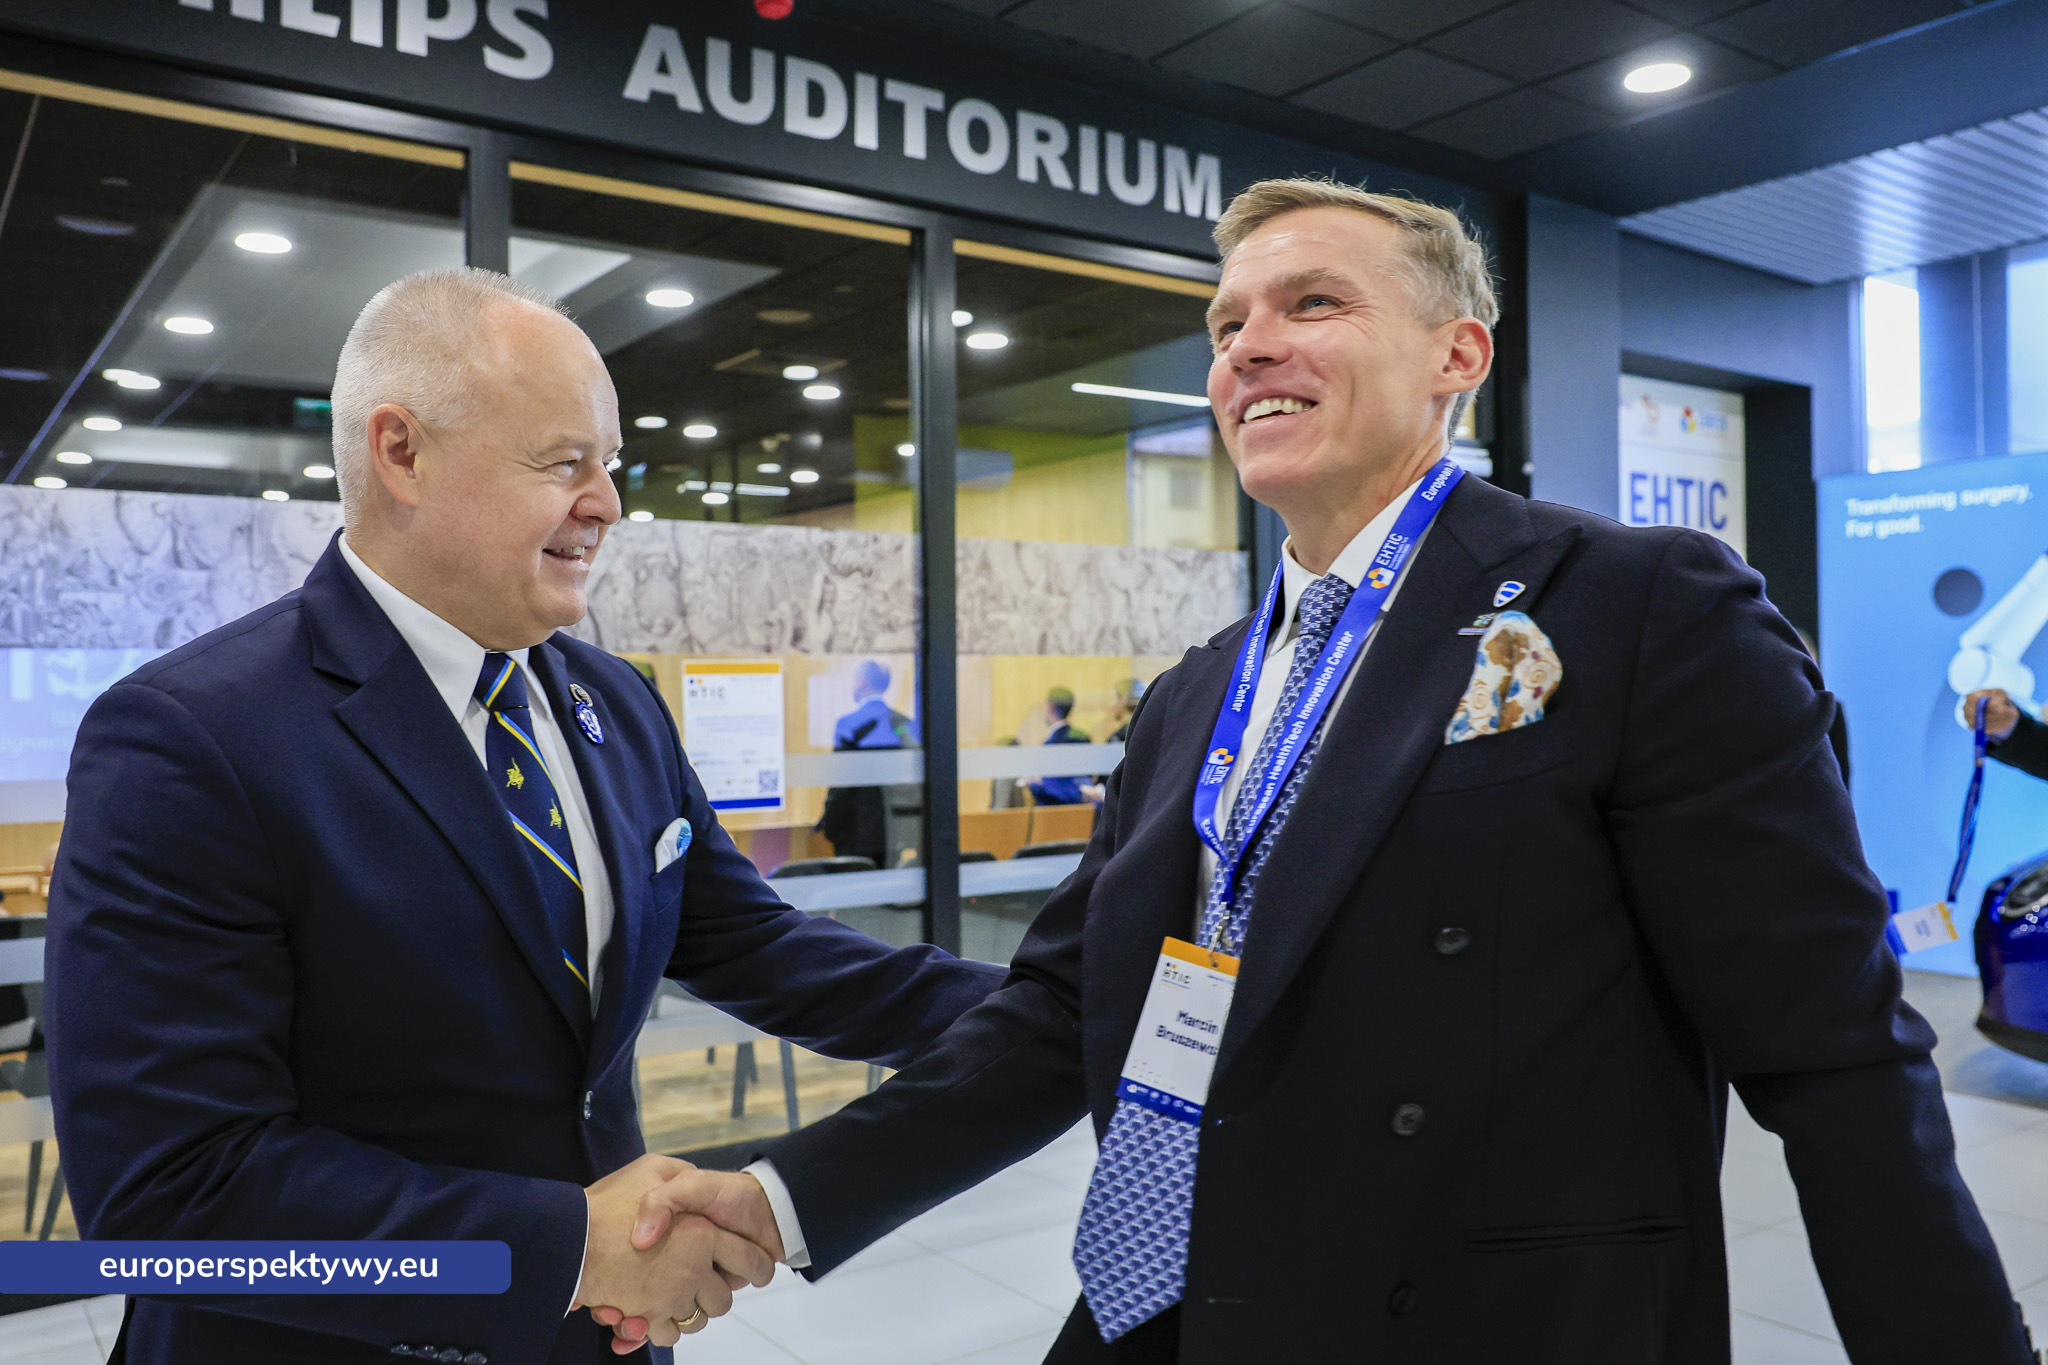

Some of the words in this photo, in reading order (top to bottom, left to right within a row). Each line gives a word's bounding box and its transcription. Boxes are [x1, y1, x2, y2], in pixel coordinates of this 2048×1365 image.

[622, 23, 1222, 221] AUDITORIUM
[1421, 467, 1455, 501] European
[1630, 472, 1728, 530] EHTIC
[1375, 533, 1403, 566] EHTIC
[1241, 633, 1262, 683] Innovation
[1231, 683, 1251, 713] Center
[1273, 719, 1307, 780] HealthTech
[1297, 666, 1335, 721] Innovation
[1326, 630, 1355, 666] Center
[1176, 1010, 1219, 1034] Marcin
